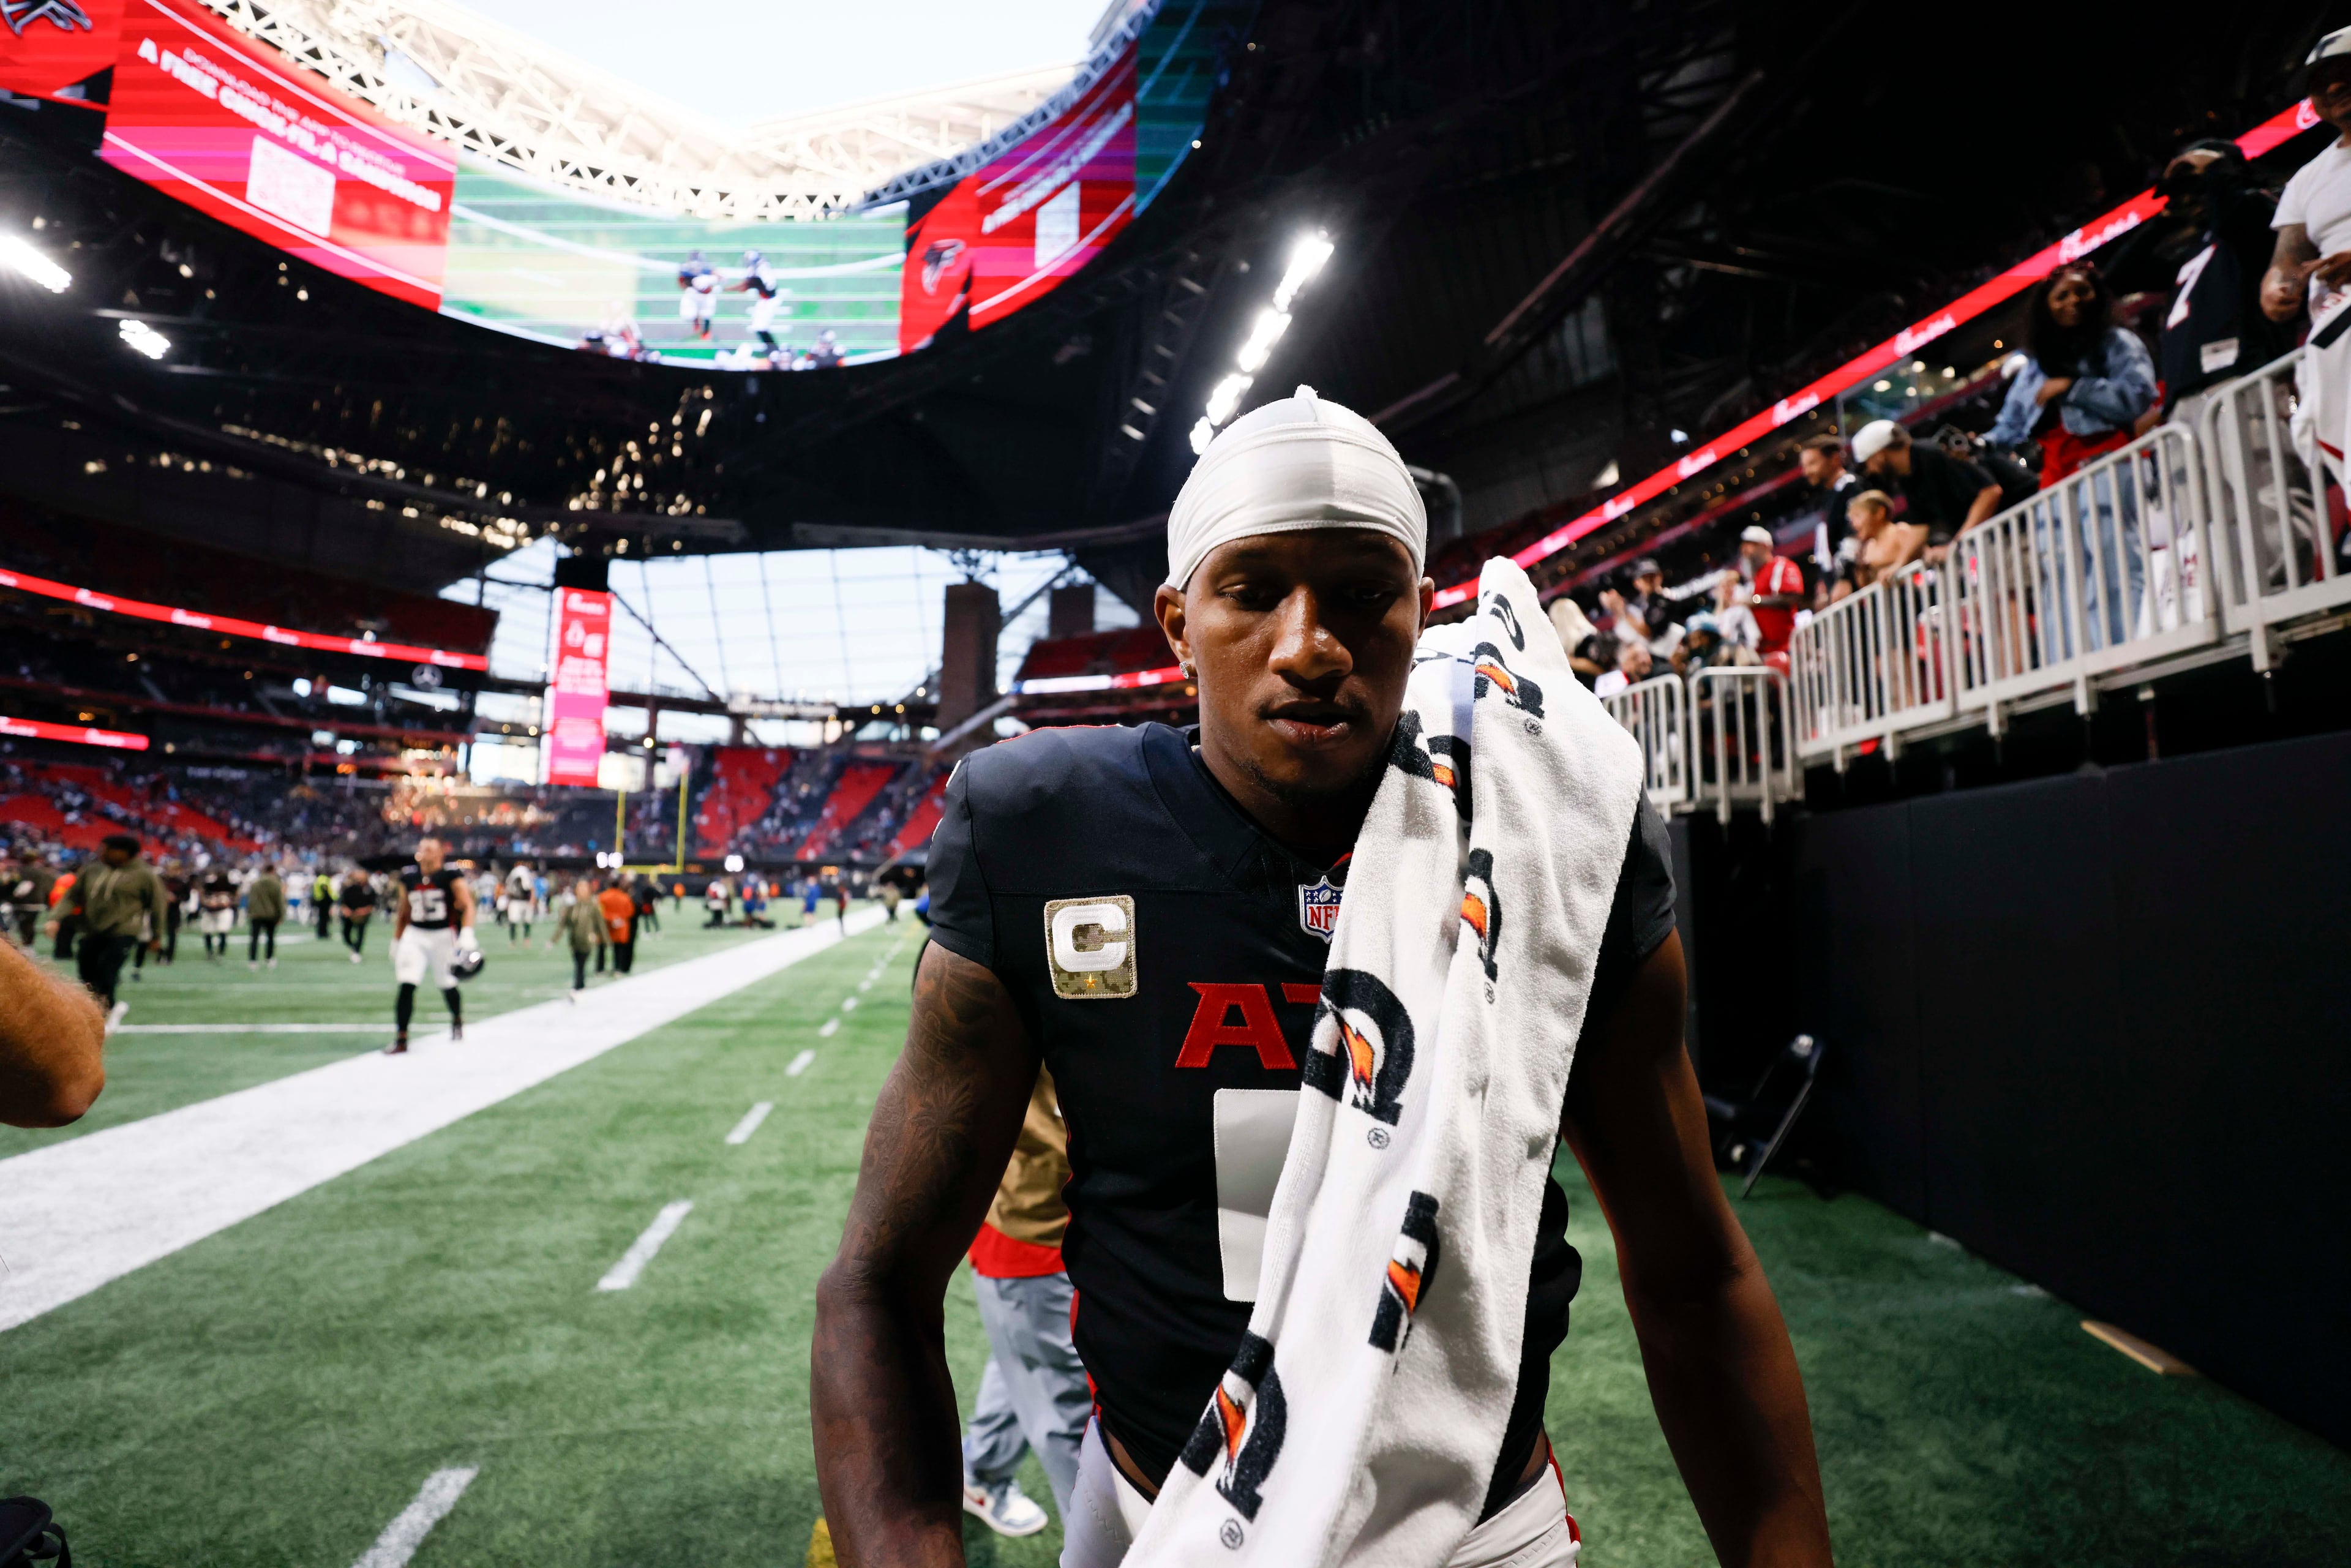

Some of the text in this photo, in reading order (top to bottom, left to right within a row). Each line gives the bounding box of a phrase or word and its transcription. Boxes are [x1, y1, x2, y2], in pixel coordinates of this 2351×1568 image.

[137, 37, 158, 64] A
[160, 49, 219, 99] FREE
[1052, 904, 1128, 972] C
